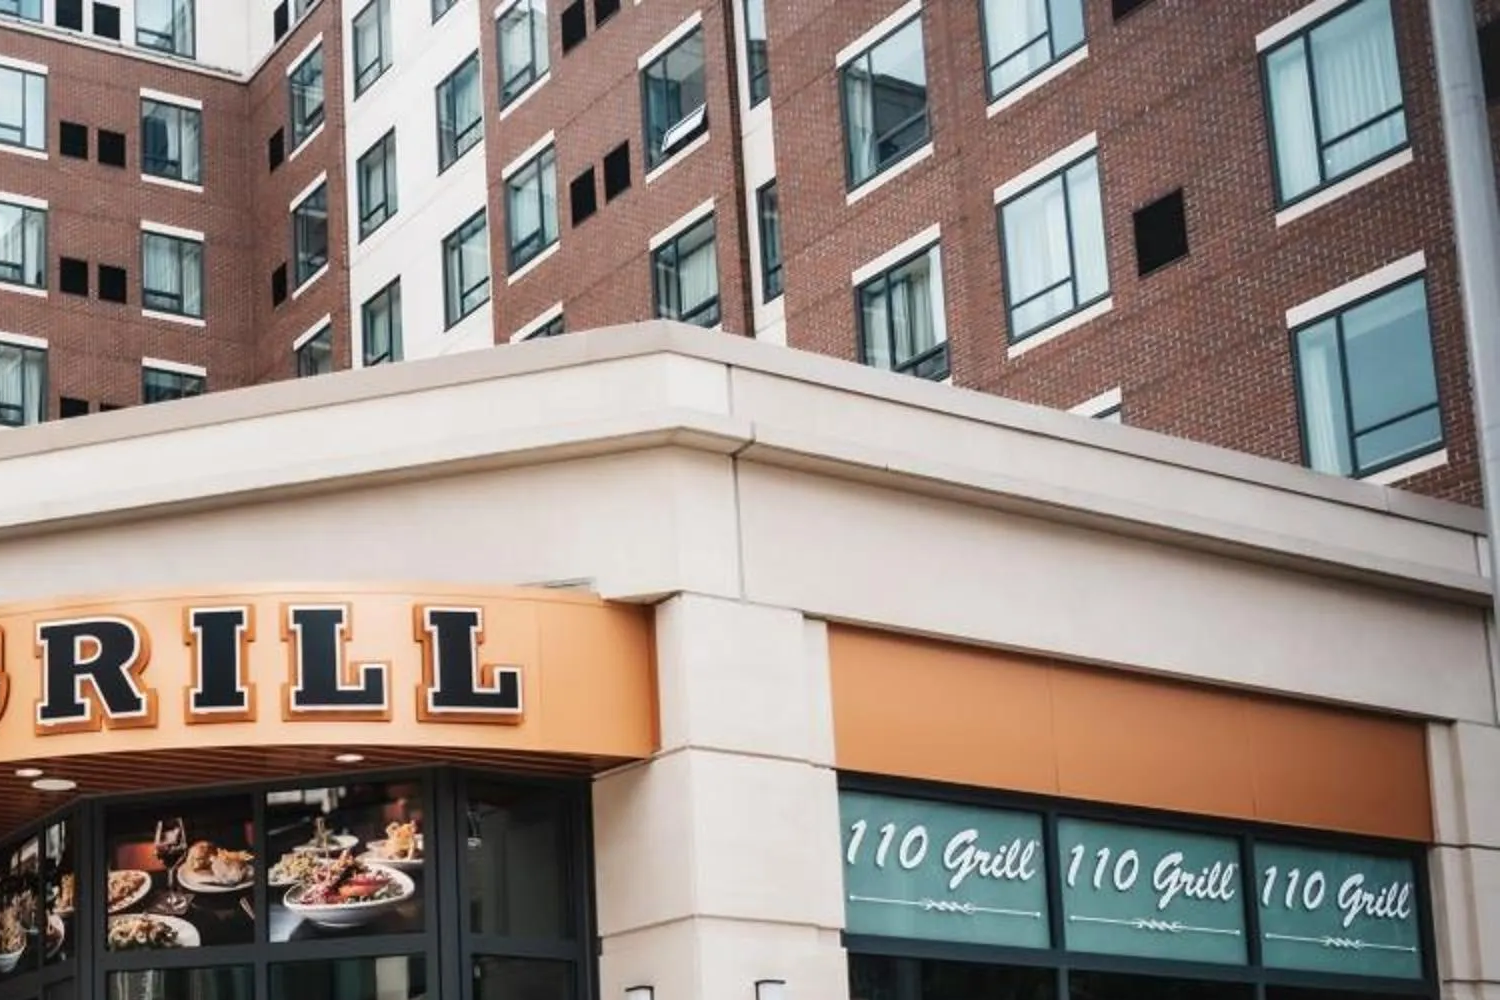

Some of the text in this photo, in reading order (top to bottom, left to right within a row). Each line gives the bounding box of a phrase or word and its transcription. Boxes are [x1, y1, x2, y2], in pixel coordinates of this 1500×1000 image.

[847, 818, 1036, 890] 110 Grill
[1067, 843, 1236, 910] 110 Grill
[1261, 865, 1411, 928] 110 Grill
